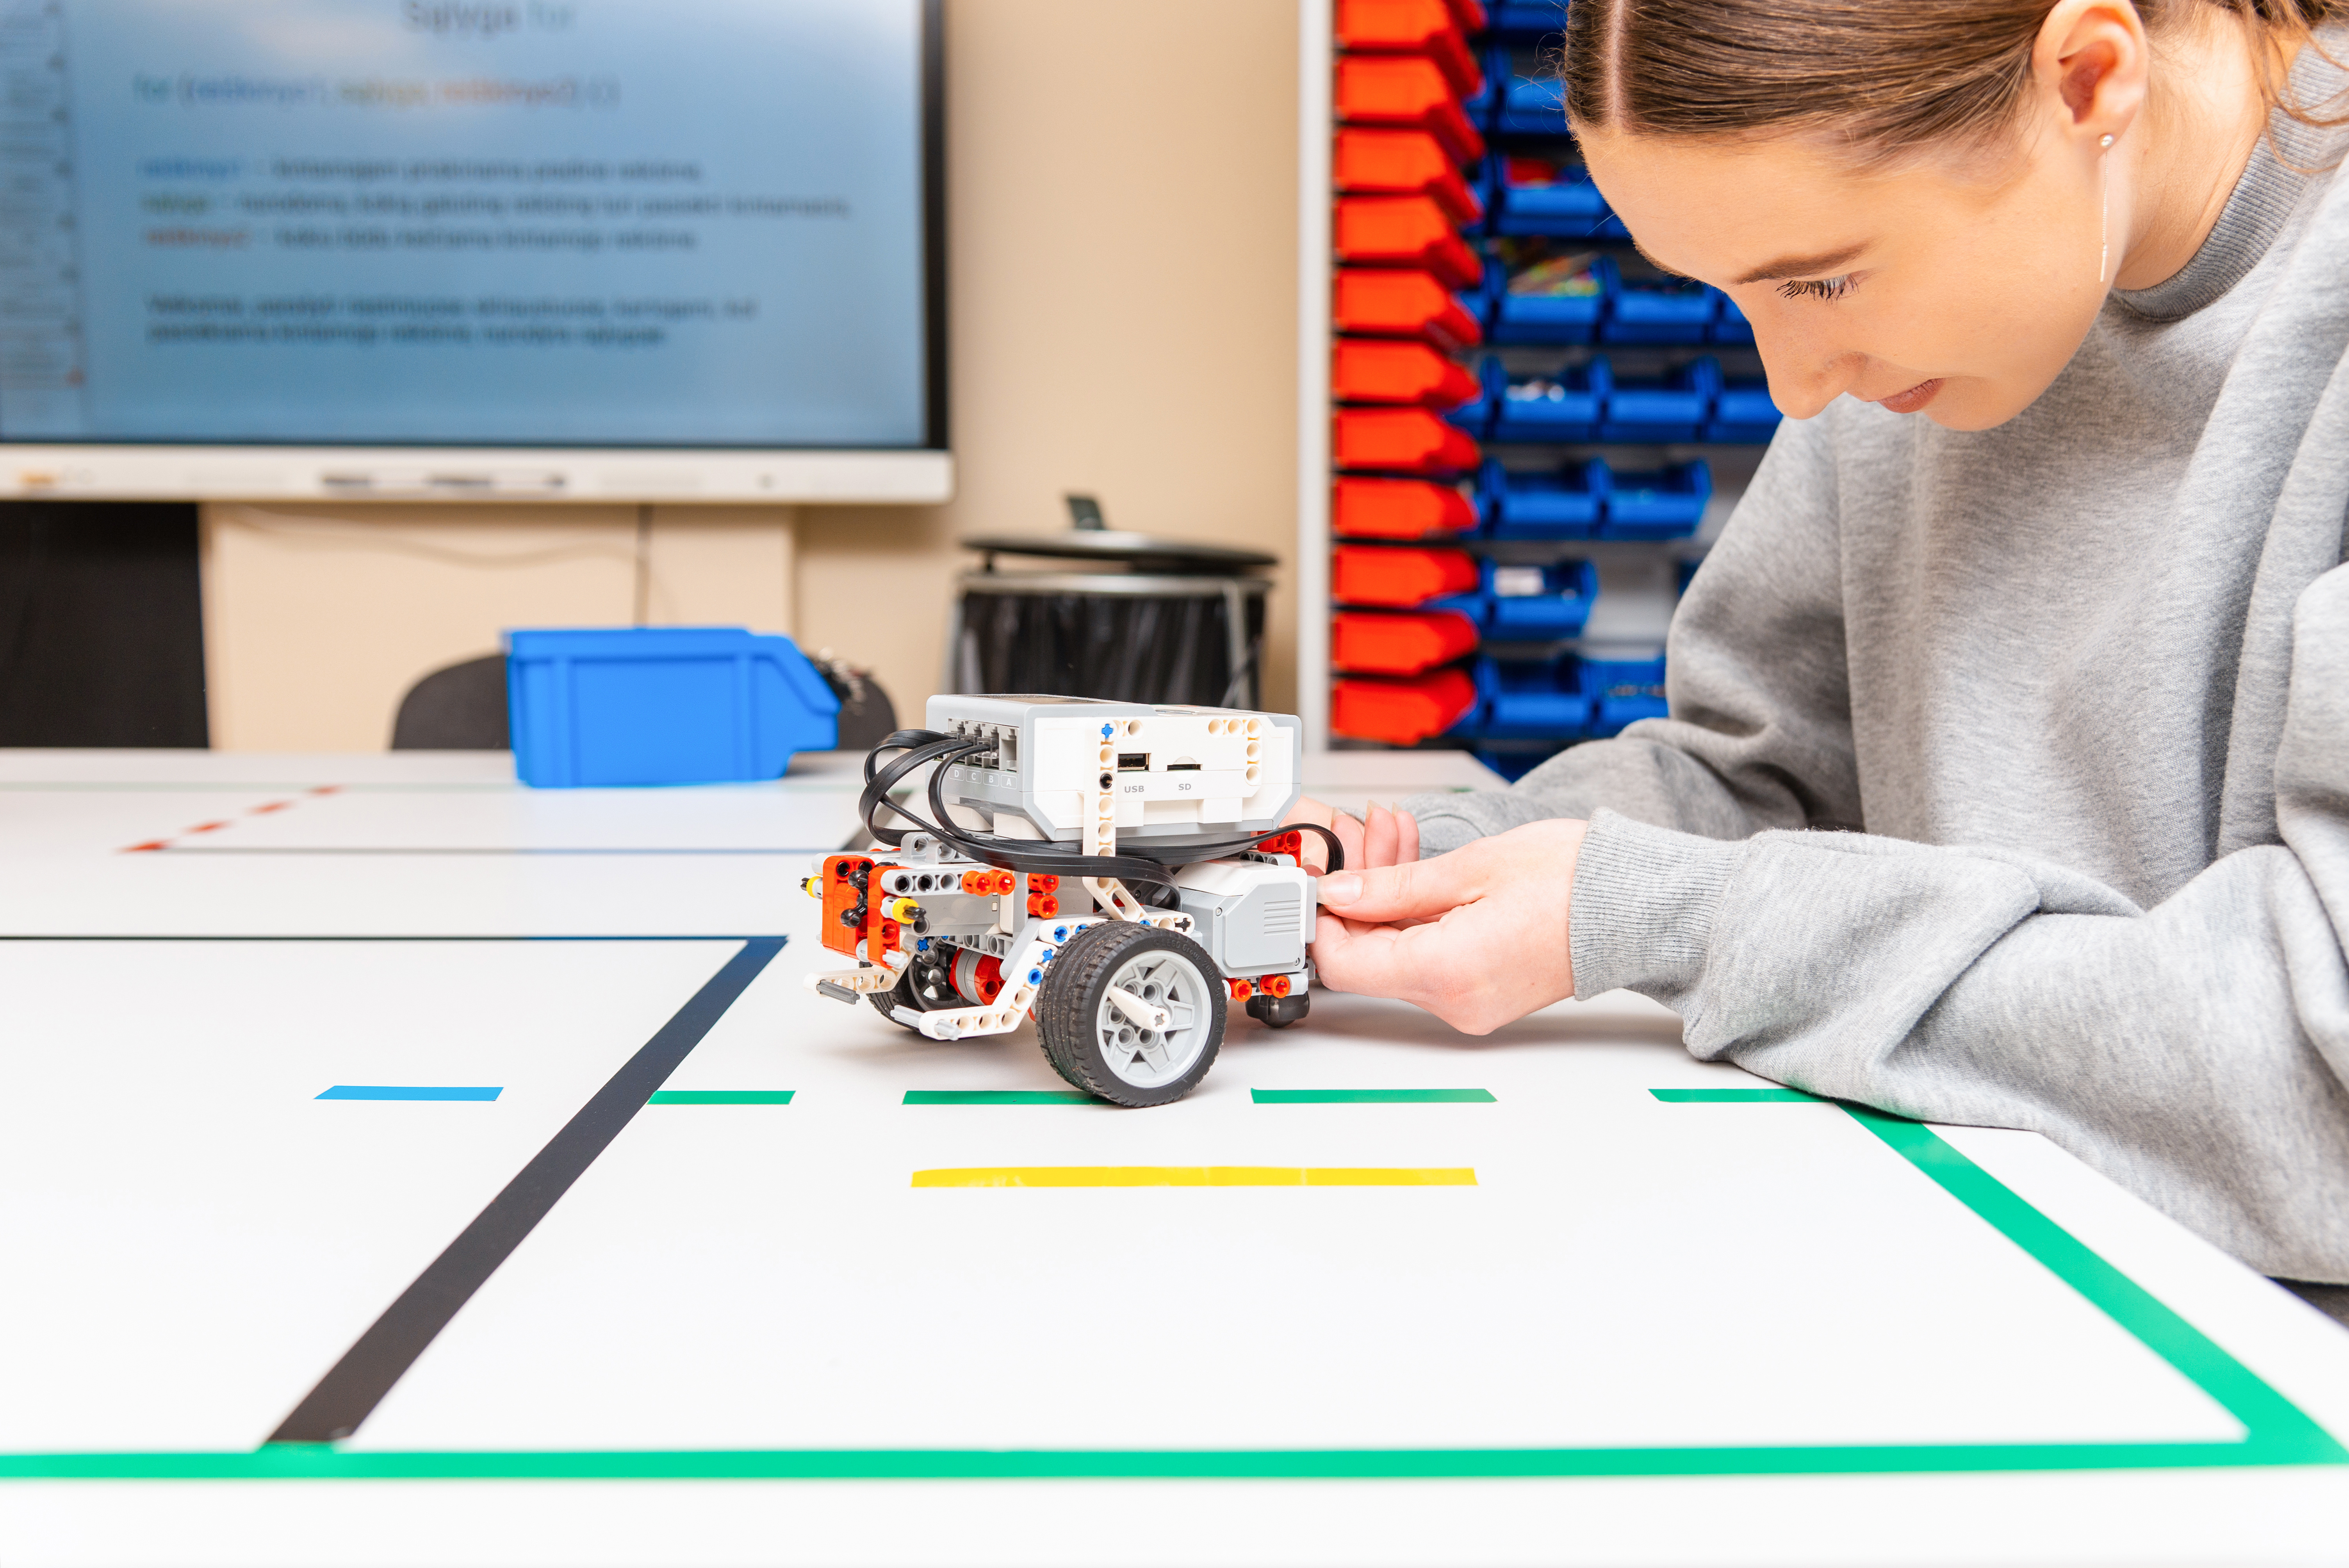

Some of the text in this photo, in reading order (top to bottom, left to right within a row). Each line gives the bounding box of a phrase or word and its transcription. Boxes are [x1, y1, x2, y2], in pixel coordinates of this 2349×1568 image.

[989, 775, 994, 783] B
[1006, 778, 1012, 786] A
[1182, 943, 1201, 961] Group
